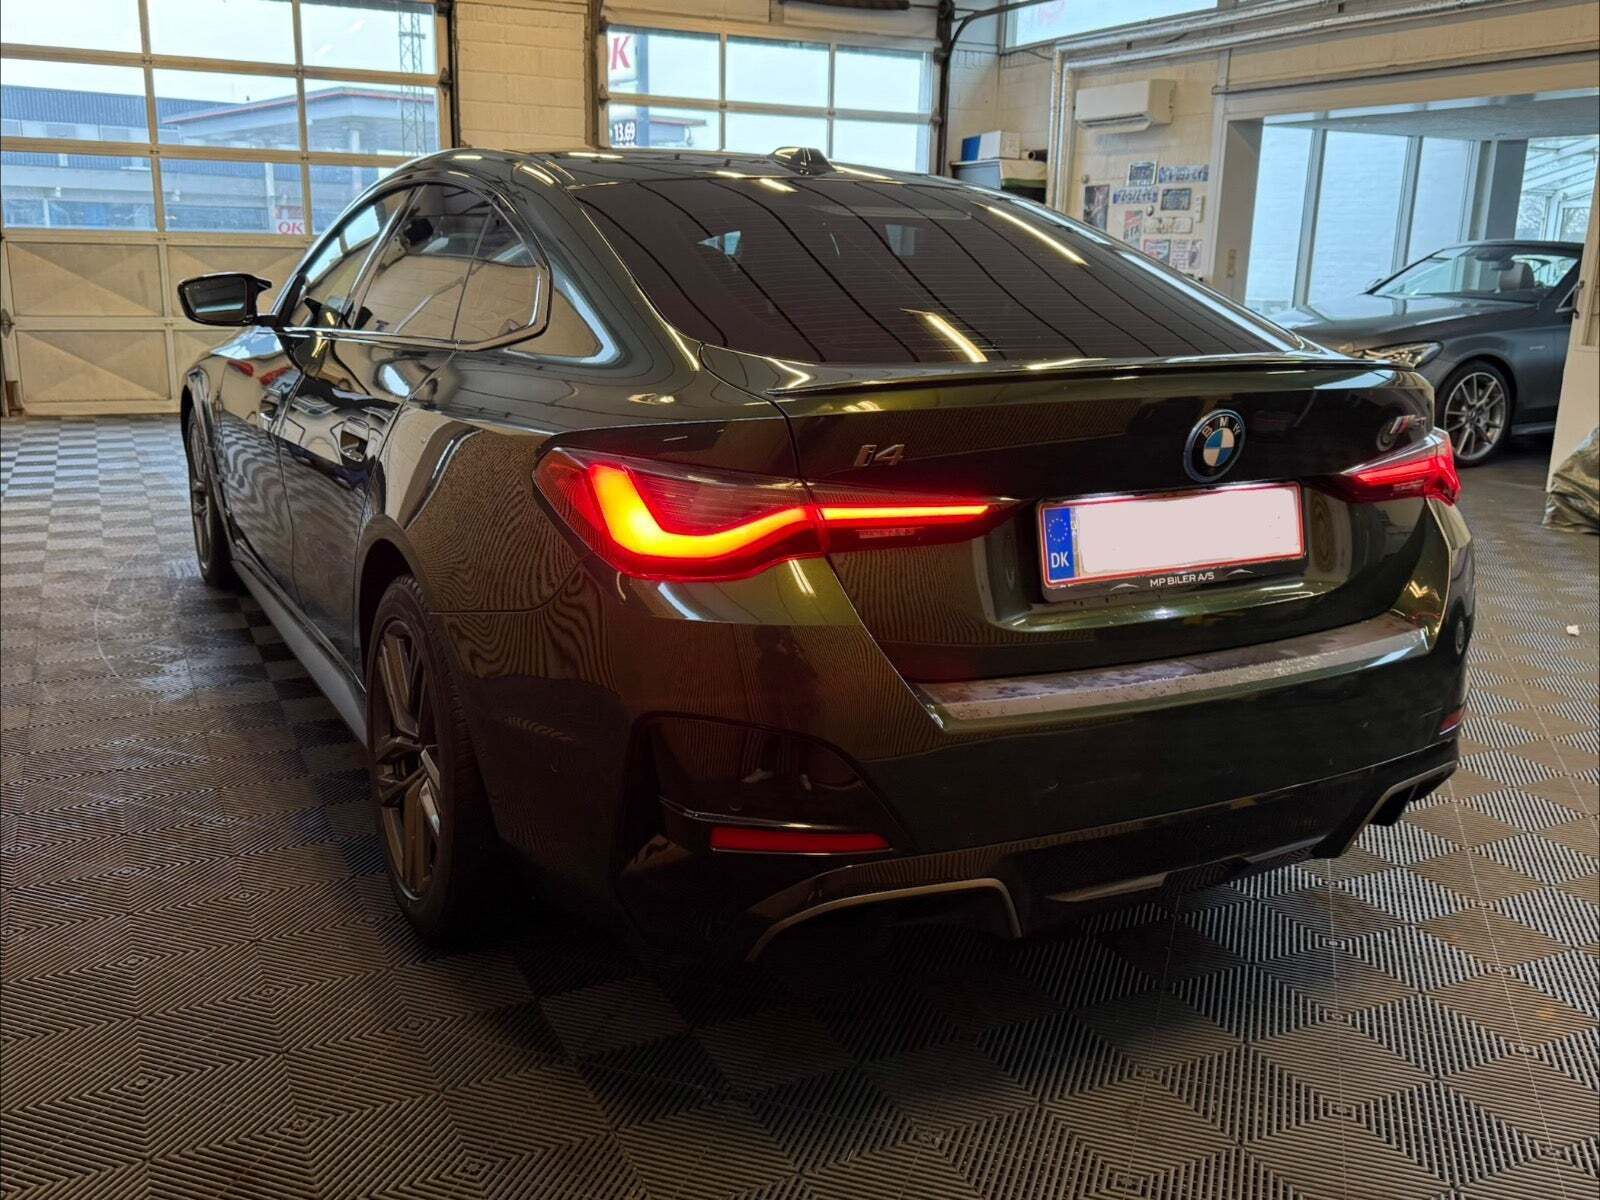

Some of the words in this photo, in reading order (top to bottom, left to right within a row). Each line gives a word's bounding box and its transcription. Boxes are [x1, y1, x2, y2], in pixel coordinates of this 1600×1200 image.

[278, 221, 304, 235] OK
[1201, 416, 1241, 438] BMW
[854, 443, 905, 467] i4
[1050, 551, 1070, 569] DK
[1149, 577, 1166, 588] MP
[1167, 573, 1196, 585] BILER
[1198, 571, 1215, 582] A/S
